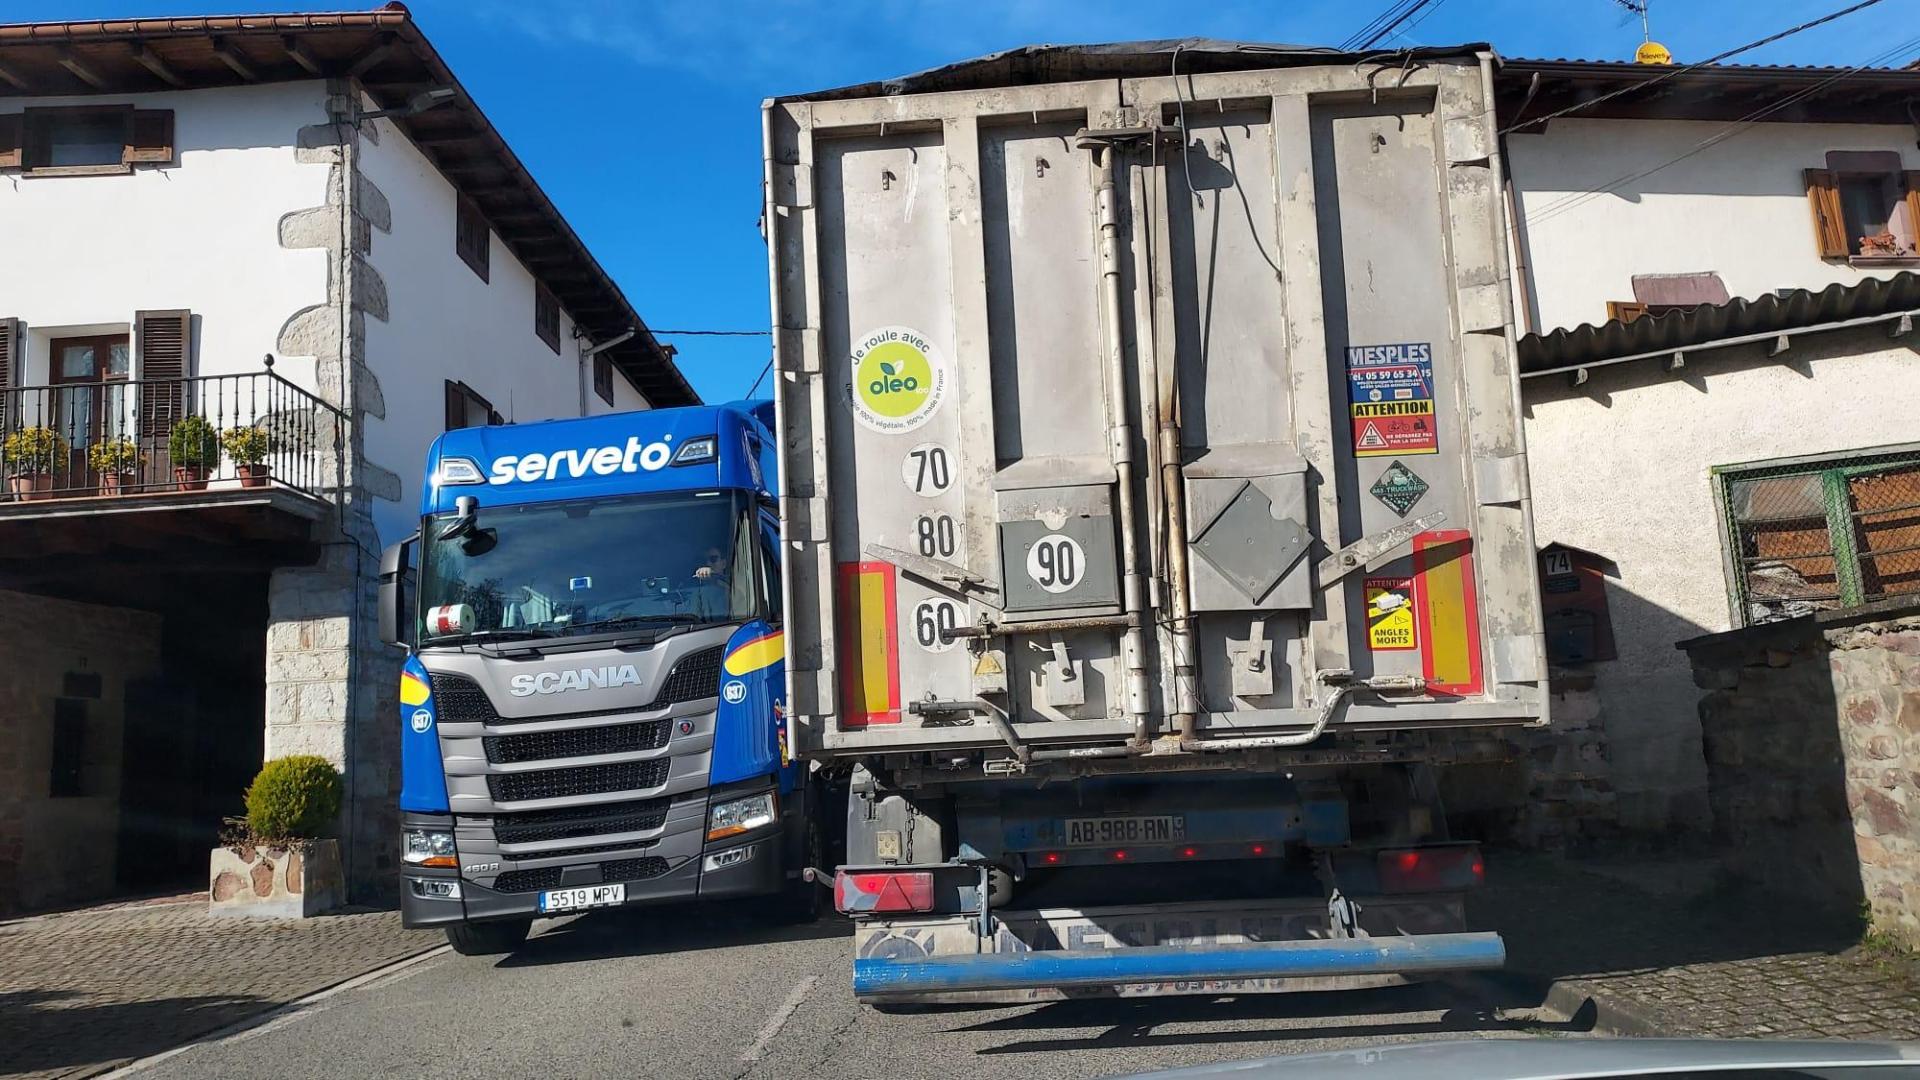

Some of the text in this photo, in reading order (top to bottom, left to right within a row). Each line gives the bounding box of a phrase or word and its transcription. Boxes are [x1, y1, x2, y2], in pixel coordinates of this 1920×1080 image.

[850, 330, 930, 365] Je roule avec
[1350, 344, 1430, 366] MESPLES
[870, 375, 918, 395] oleo
[1365, 372, 1377, 381] 05
[1379, 371, 1391, 380] 59
[1393, 370, 1404, 379] 65
[1406, 369, 1418, 379] 34
[1356, 401, 1429, 416] ATTENTION
[488, 436, 671, 485] serveto
[910, 448, 949, 492] 70
[918, 515, 955, 558] 80
[1038, 541, 1075, 587] 90
[1547, 552, 1569, 573] 74
[1367, 580, 1411, 588] ATTENTION
[916, 602, 955, 647] 60
[1374, 628, 1410, 636] ANGLES
[1376, 636, 1409, 645] MORTS
[510, 664, 642, 697] SCANIA
[464, 863, 488, 872] 460
[551, 886, 619, 907] 5519 MPV
